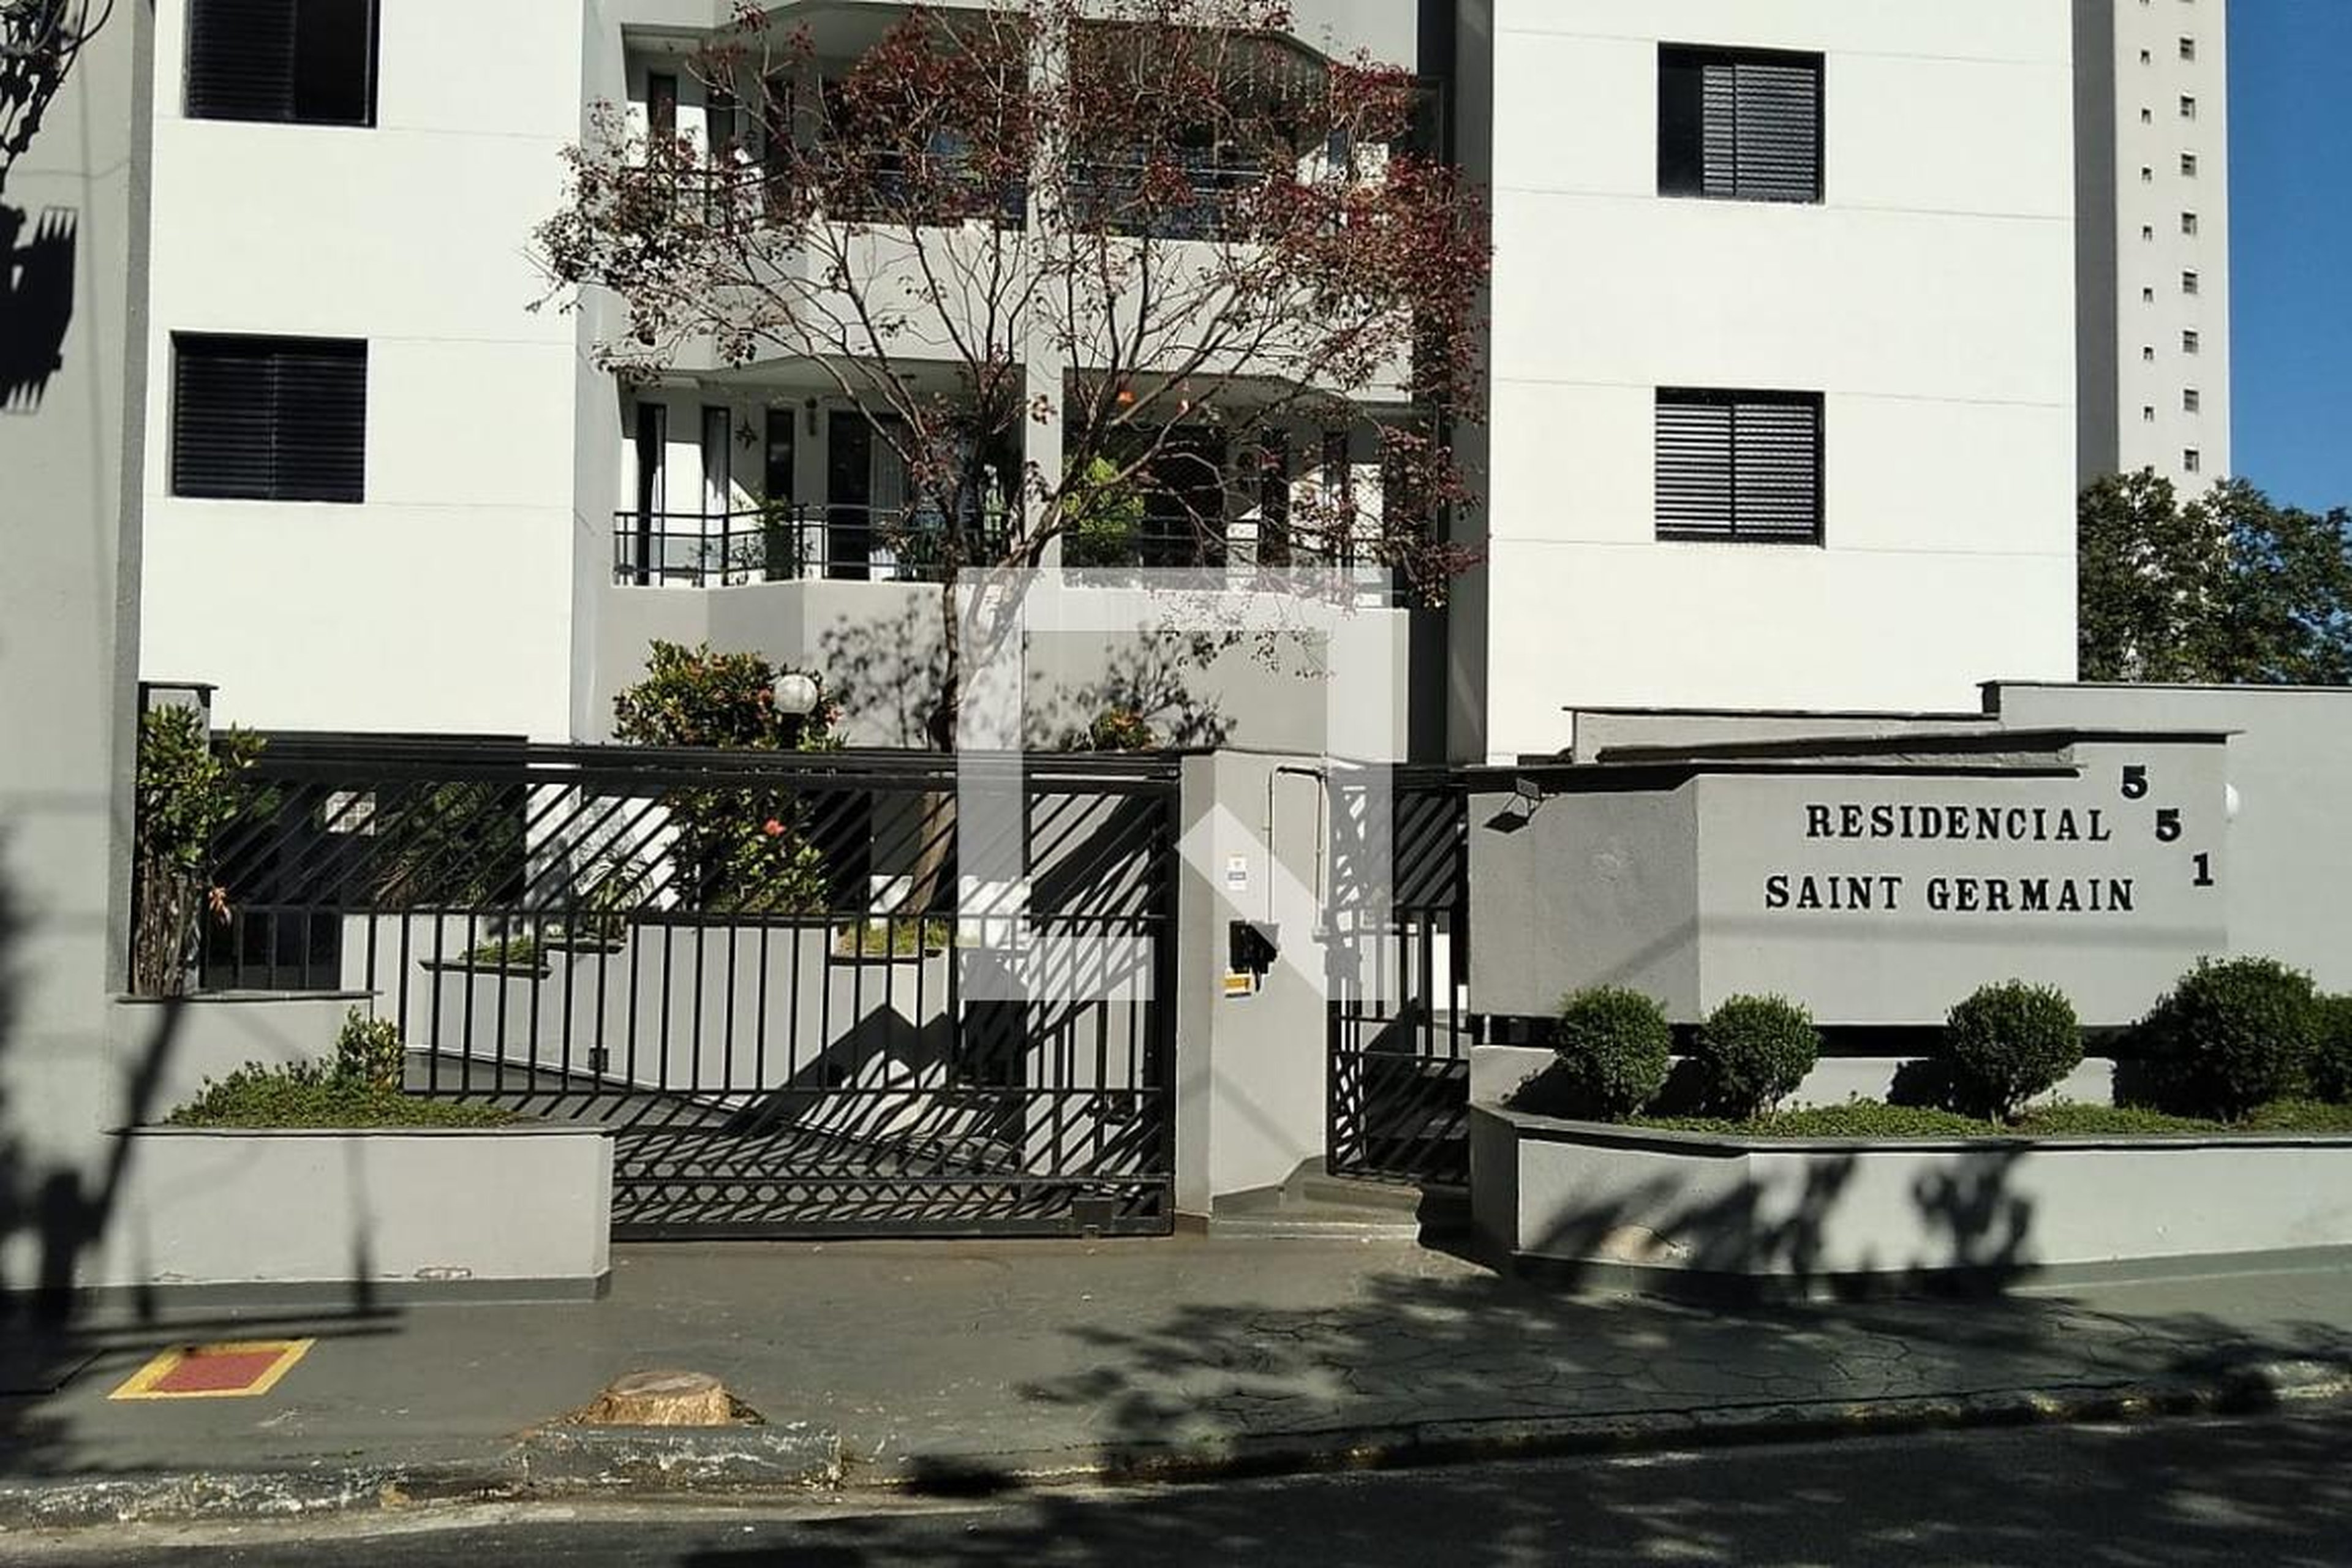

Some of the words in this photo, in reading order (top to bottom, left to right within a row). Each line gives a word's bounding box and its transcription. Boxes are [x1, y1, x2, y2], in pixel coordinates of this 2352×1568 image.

[1806, 804, 2111, 841] RESIDENCIAL
[1765, 875, 1902, 909] SAINT
[1927, 878, 2133, 911] GERMAIN
